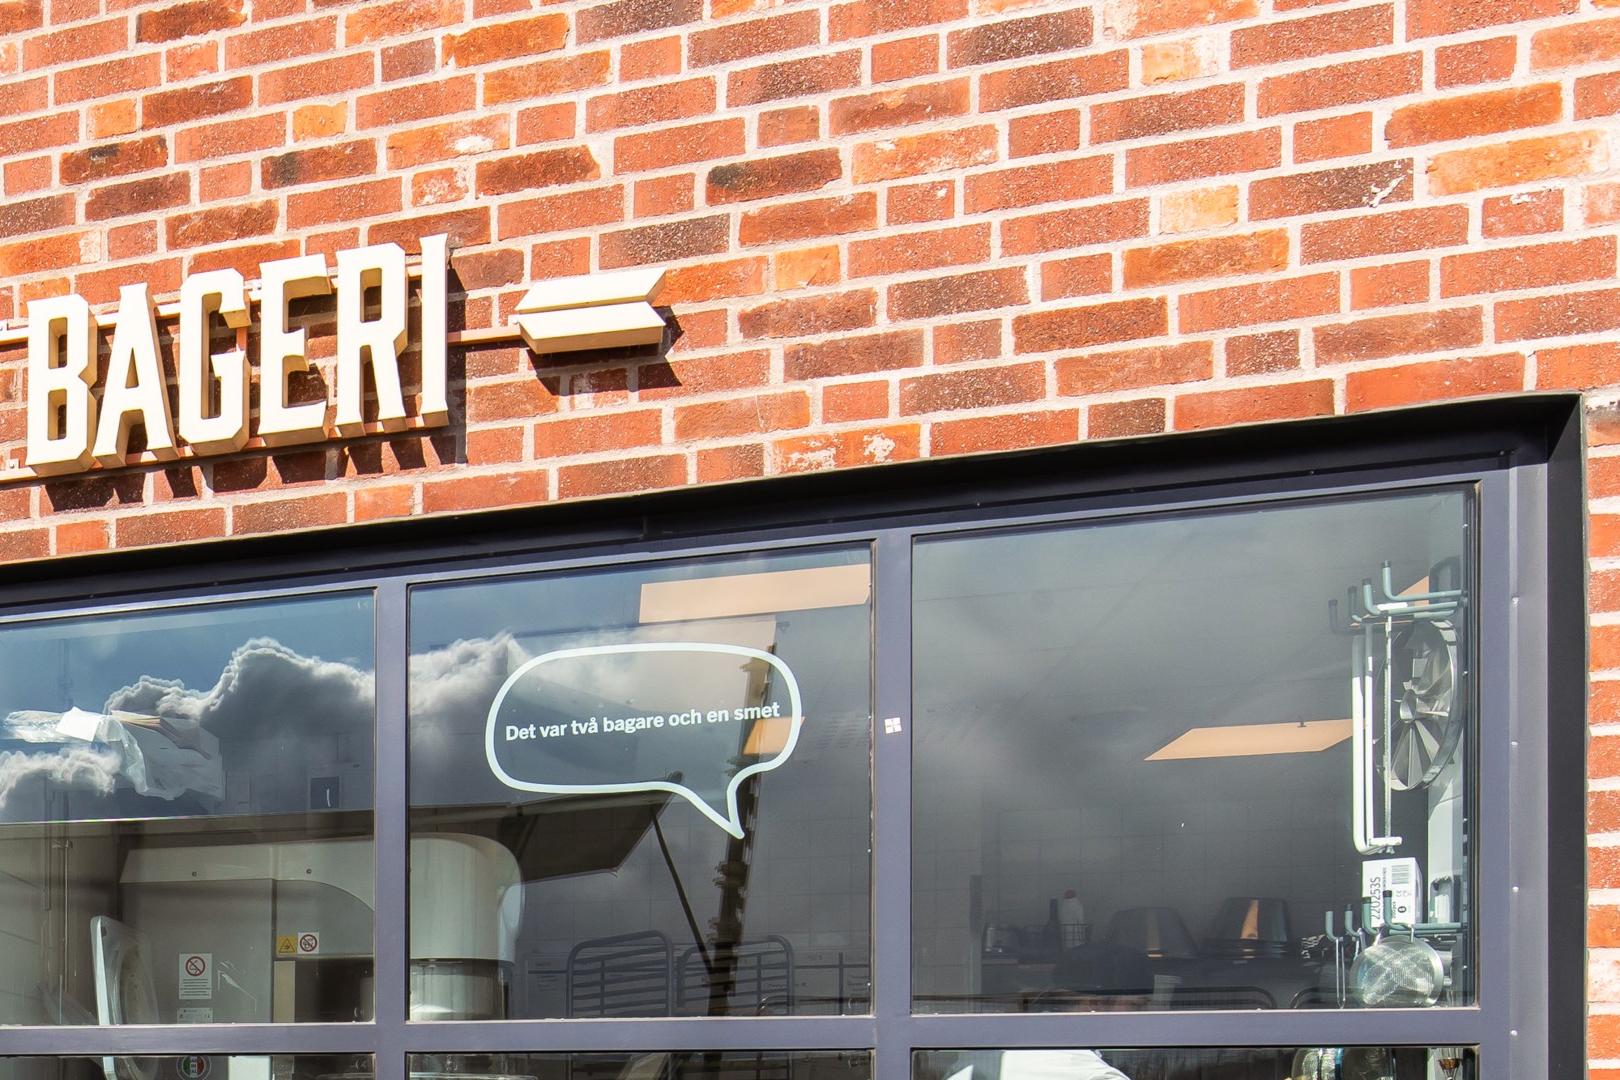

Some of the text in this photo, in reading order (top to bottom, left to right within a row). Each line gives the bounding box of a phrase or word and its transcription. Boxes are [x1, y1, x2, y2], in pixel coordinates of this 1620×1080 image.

[25, 233, 448, 466] BAGERI
[505, 701, 781, 741] Det var två bagare och en smet
